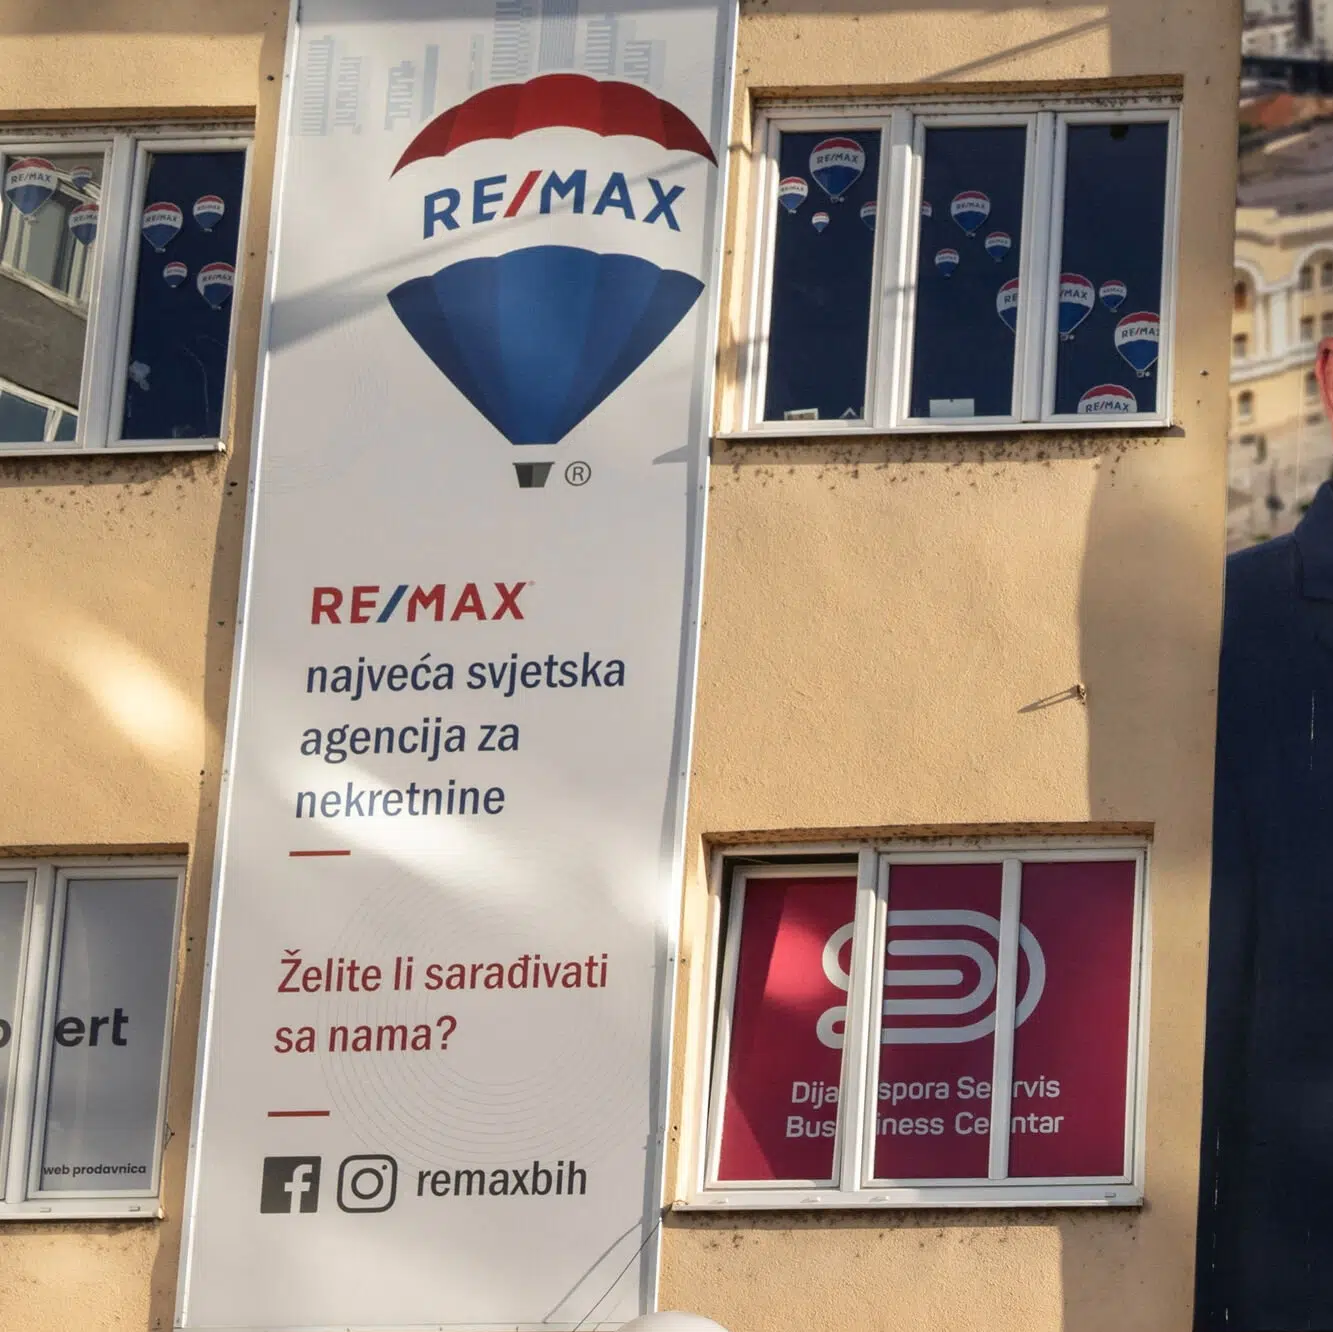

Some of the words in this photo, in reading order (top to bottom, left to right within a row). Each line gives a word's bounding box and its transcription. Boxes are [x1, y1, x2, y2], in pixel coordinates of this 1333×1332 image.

[11, 174, 51, 184] RE/MAX
[816, 154, 859, 165] RE/MAX
[422, 169, 687, 240] RE/MAX
[310, 582, 528, 625] RE/MAX
[306, 652, 455, 701] najveća
[466, 651, 626, 698] svjetska
[300, 717, 466, 764] agencija
[477, 722, 520, 752] za
[295, 779, 506, 819] nekretnine
[277, 949, 382, 993] Želite
[394, 957, 413, 991] li
[424, 953, 609, 991] sarađivati
[273, 1024, 316, 1053] sa
[328, 1015, 457, 1053] nama?
[43, 1164, 69, 1175] web
[72, 1162, 147, 1177] prodavnica
[417, 1160, 587, 1197] remaxbih
